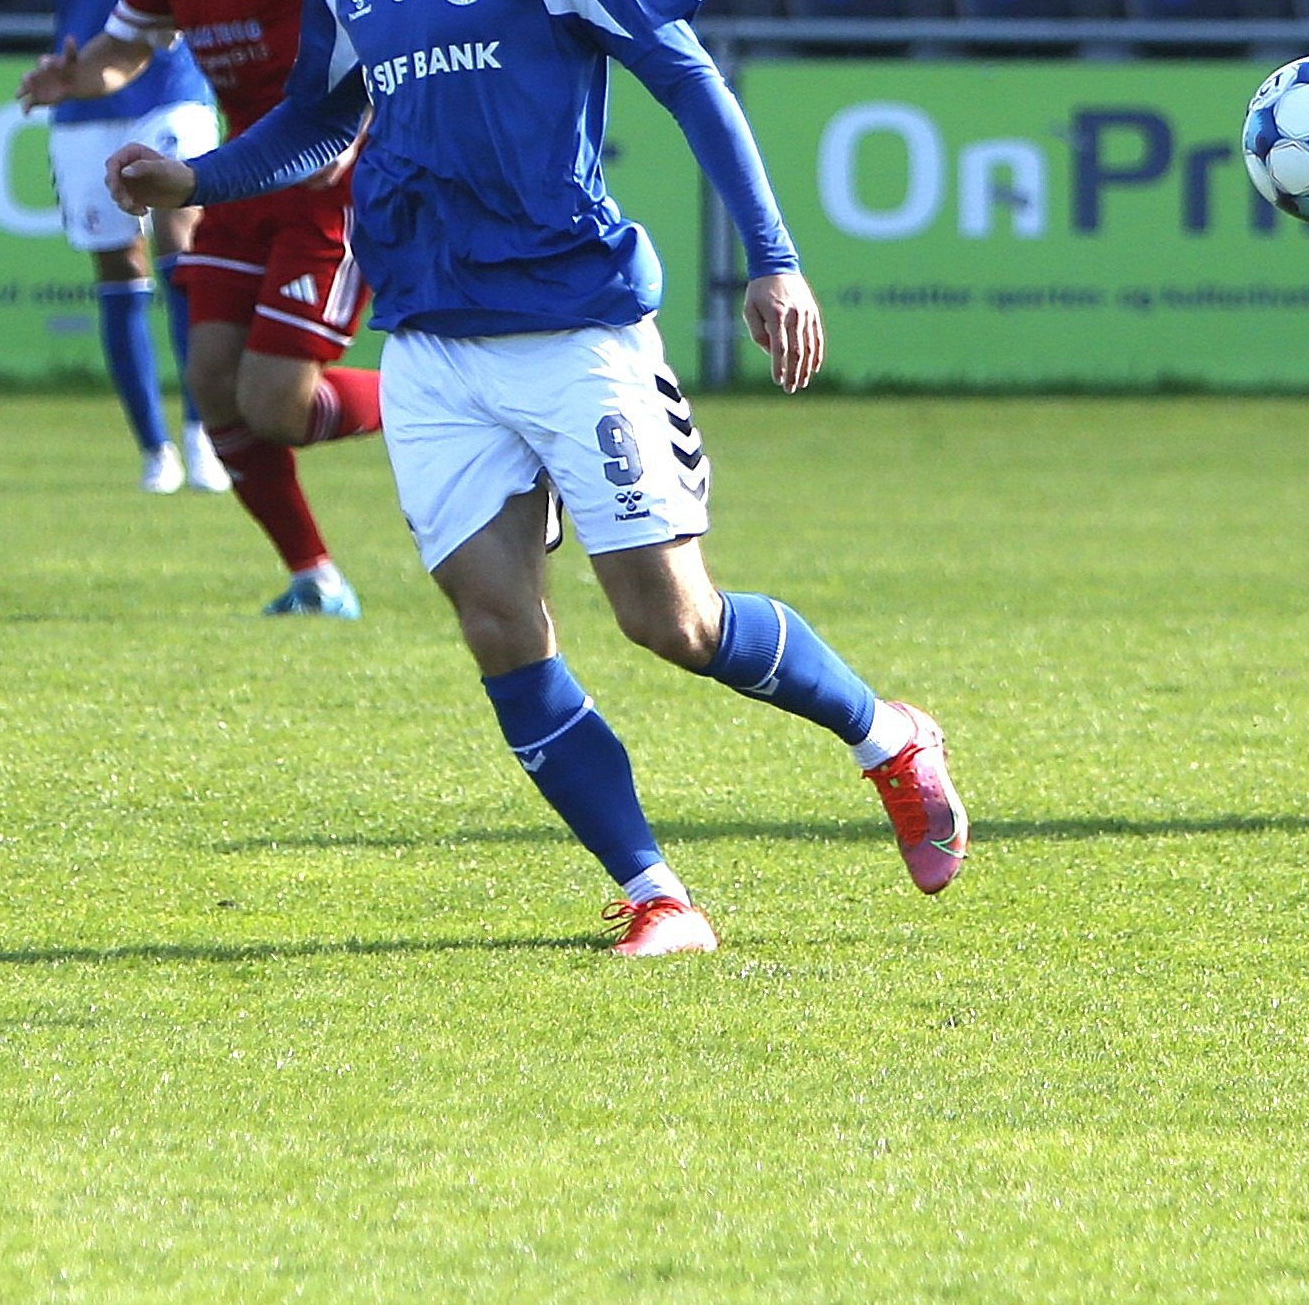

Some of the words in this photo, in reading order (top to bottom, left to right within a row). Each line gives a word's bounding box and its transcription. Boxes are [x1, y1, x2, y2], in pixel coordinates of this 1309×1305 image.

[373, 55, 409, 96] SJF
[413, 41, 502, 79] BANK
[596, 410, 644, 487] 9
[615, 509, 651, 522] hummel
